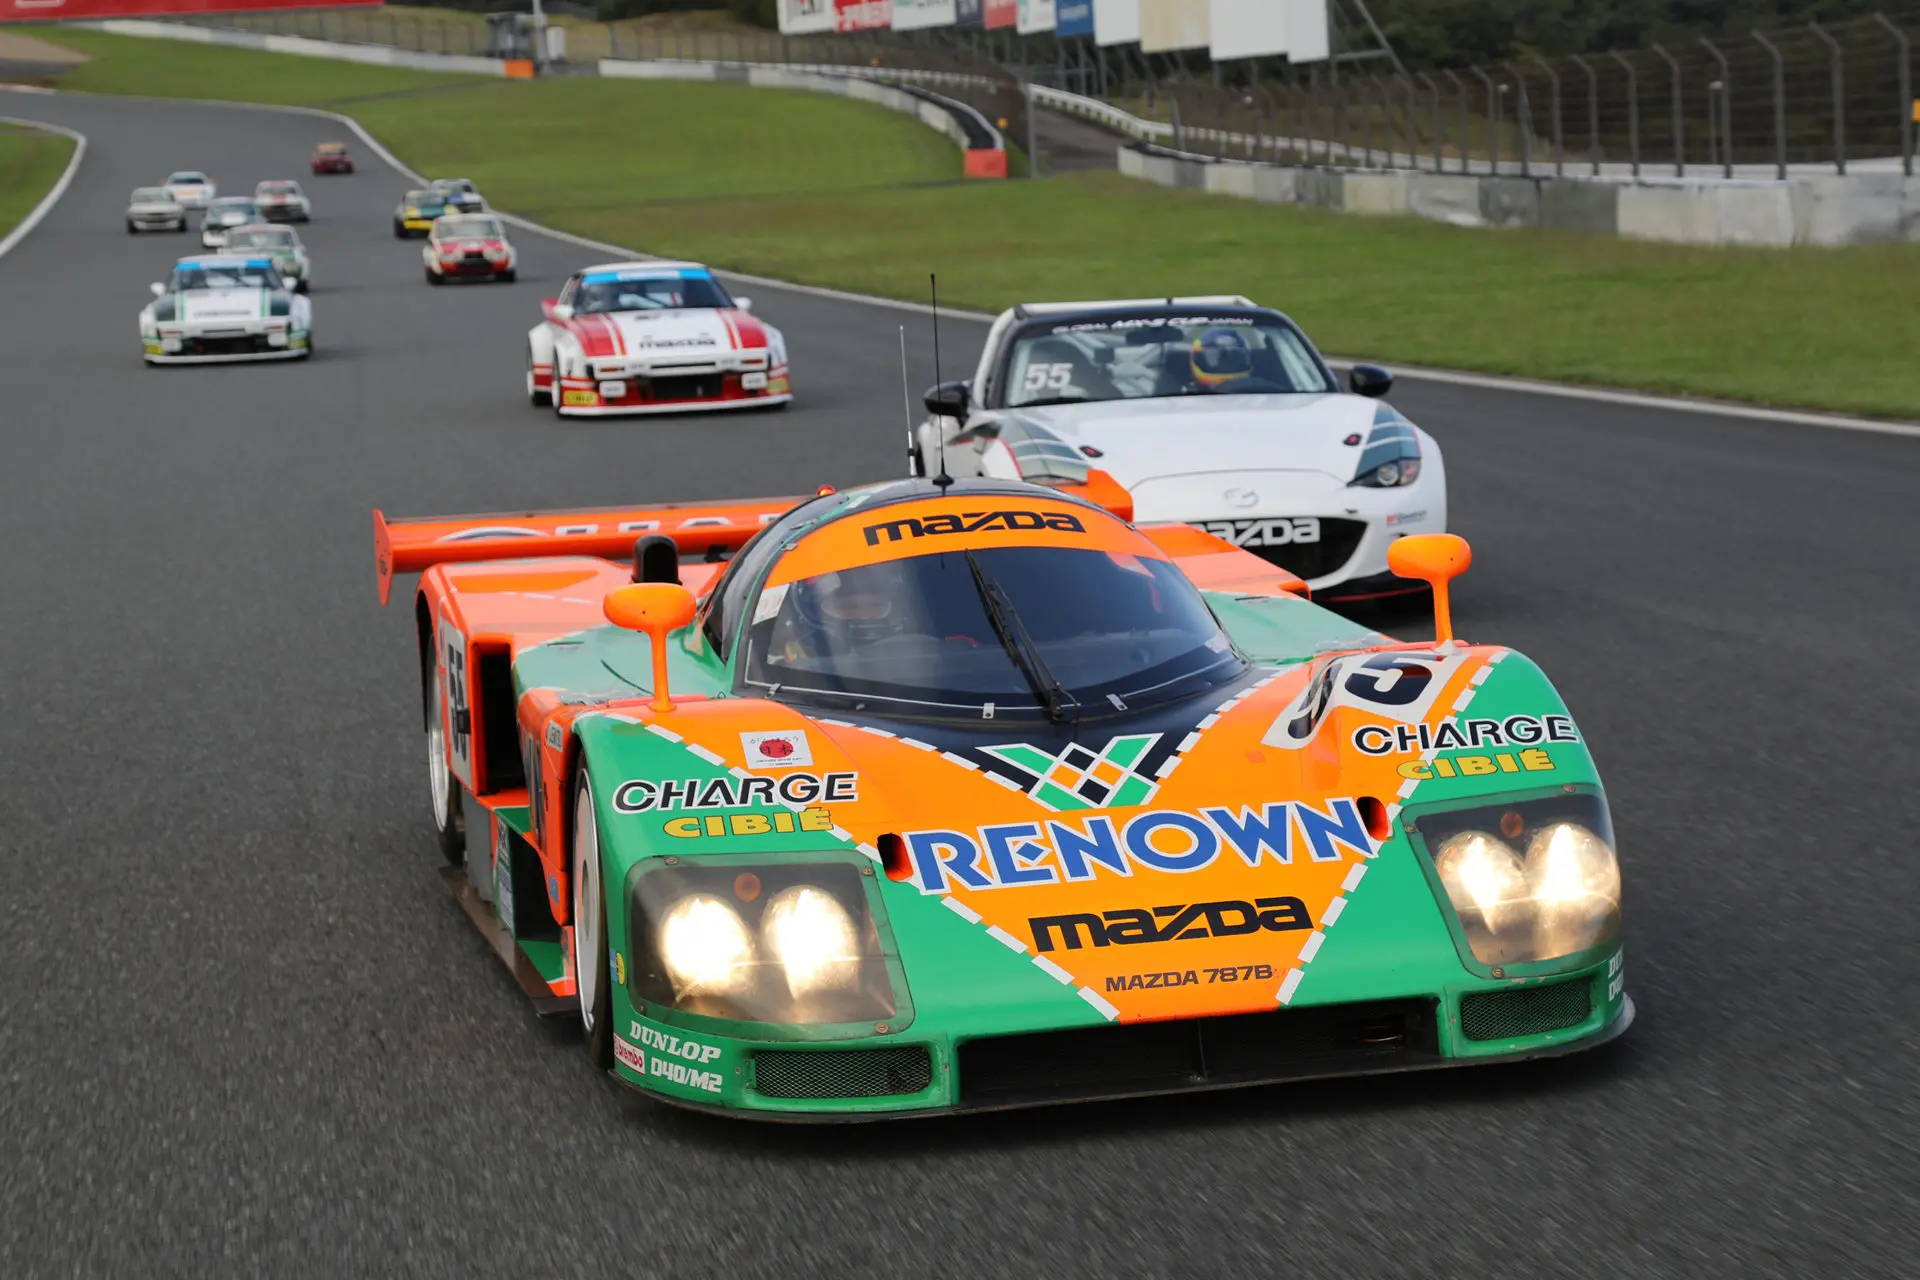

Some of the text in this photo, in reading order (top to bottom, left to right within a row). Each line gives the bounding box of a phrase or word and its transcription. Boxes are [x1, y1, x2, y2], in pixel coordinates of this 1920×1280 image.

[1025, 362, 1074, 390] 55
[1187, 517, 1321, 548] azda
[1352, 714, 1580, 756] CHARGE
[1396, 748, 1556, 780] CIBIÉ
[612, 771, 860, 814] CHARGE
[663, 807, 834, 839] CIBIÉ
[901, 796, 1380, 895] RENOWN
[1105, 963, 1274, 993] MAZDA 787B
[629, 1020, 722, 1064] DUNLOP
[651, 1056, 723, 1094] D40/M2
